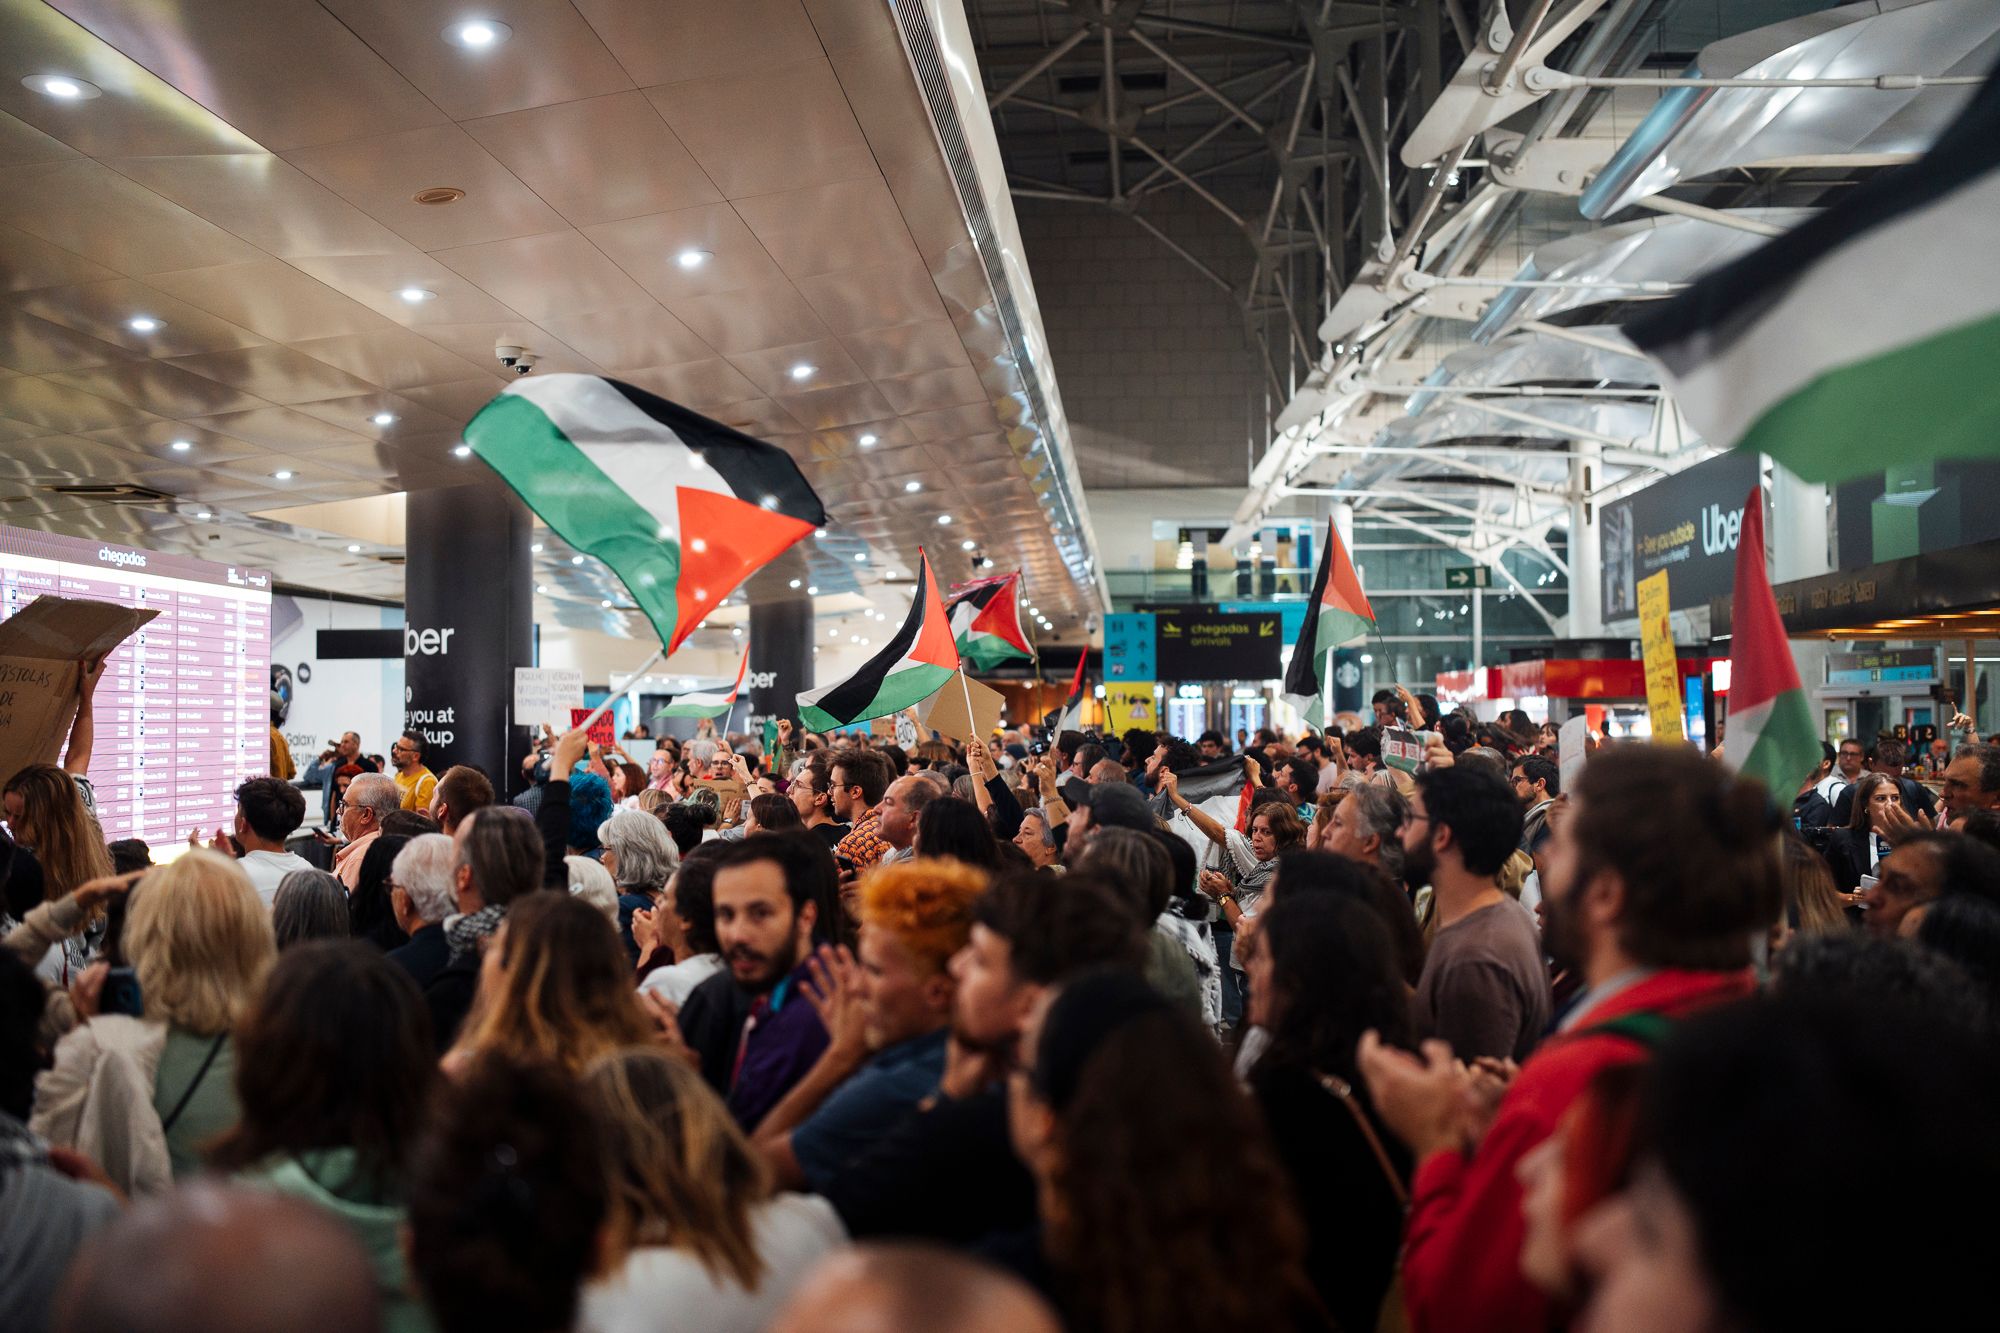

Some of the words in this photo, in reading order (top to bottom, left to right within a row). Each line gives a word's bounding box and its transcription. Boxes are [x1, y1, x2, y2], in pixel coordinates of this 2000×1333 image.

[98, 547, 147, 567] chegadas
[1190, 622, 1249, 636] chegadas
[1190, 636, 1232, 647] arrivals
[410, 710, 434, 727] you
[437, 707, 455, 723] at
[286, 732, 318, 749] Galaxy
